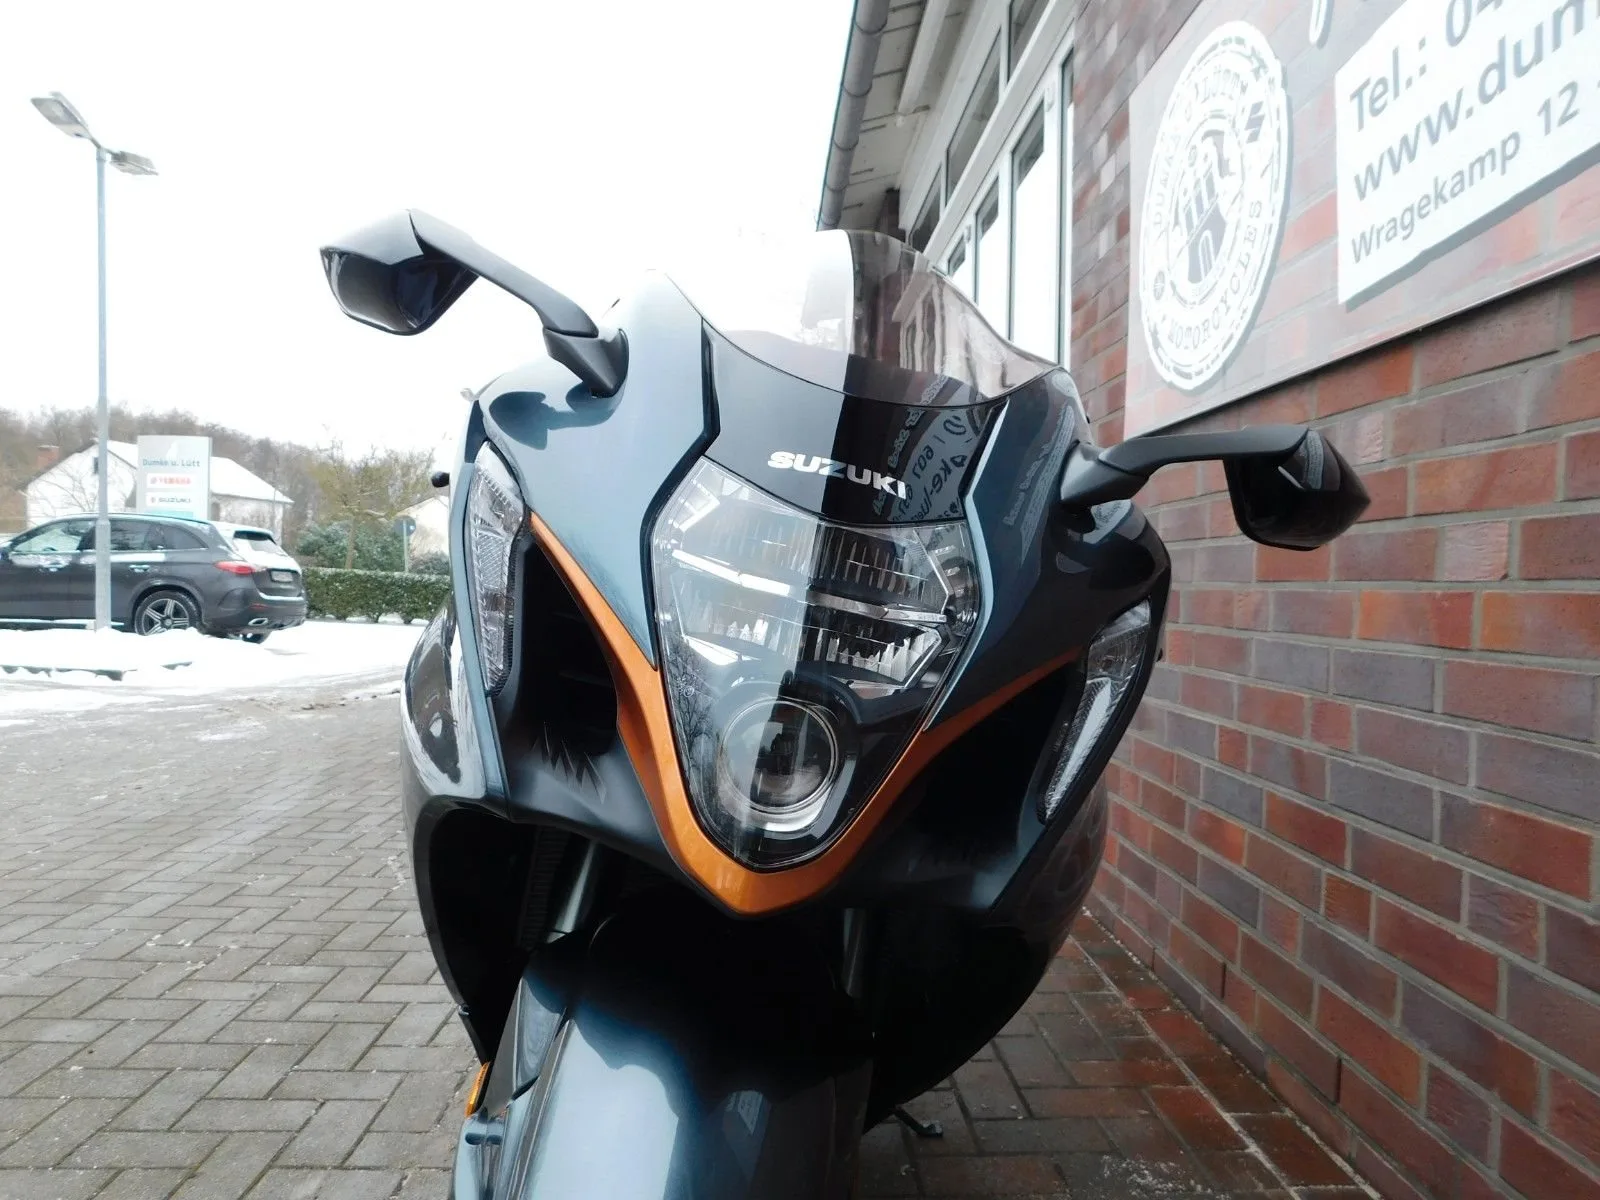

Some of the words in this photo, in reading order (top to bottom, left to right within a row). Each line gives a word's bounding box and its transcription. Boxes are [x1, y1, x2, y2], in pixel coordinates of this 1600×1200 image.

[1349, 37, 1427, 131] Tel.:
[1351, 130, 1521, 264] Wragekamp
[1536, 80, 1580, 138] 12
[767, 450, 907, 499] SUZUKI
